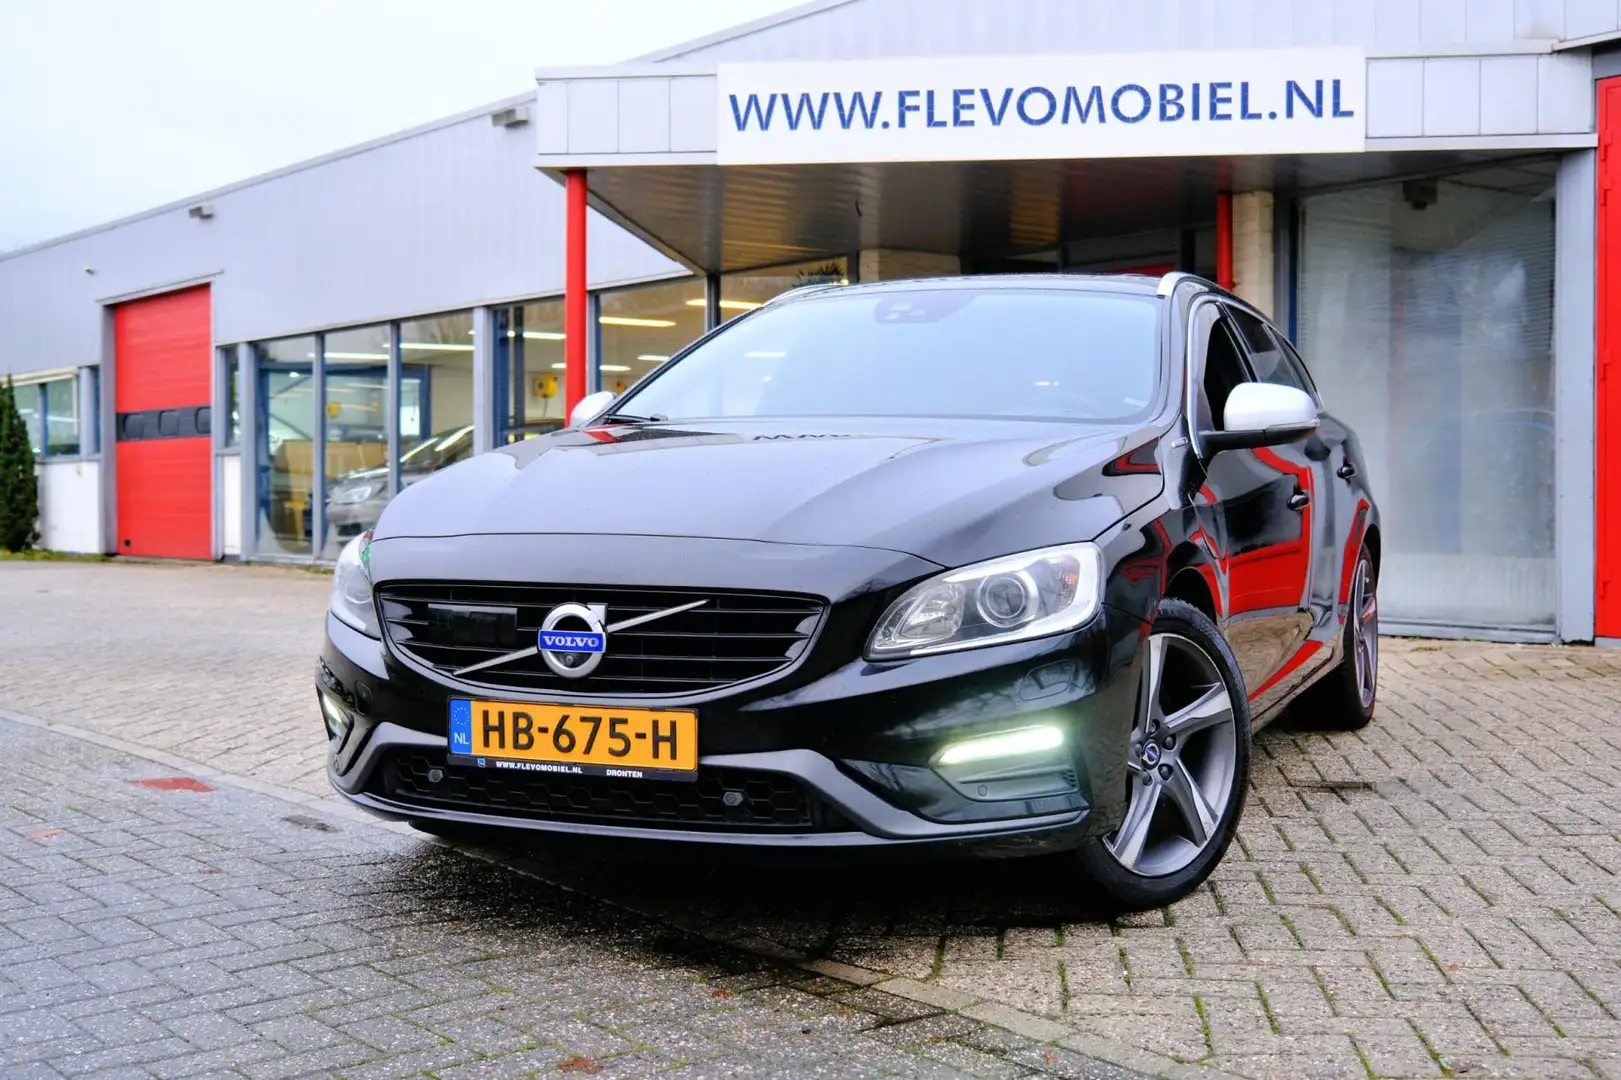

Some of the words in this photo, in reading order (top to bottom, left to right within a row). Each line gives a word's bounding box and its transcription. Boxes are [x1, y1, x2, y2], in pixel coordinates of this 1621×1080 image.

[729, 78, 1355, 132] WWW.FLEVOMOBIEL.NL
[542, 634, 600, 648] VOLVO
[454, 732, 469, 745] NL
[482, 709, 678, 760] HB-675-H
[495, 761, 583, 774] WWW.FLEVOMOBIEL.NL
[606, 769, 643, 779] DRONTEN
